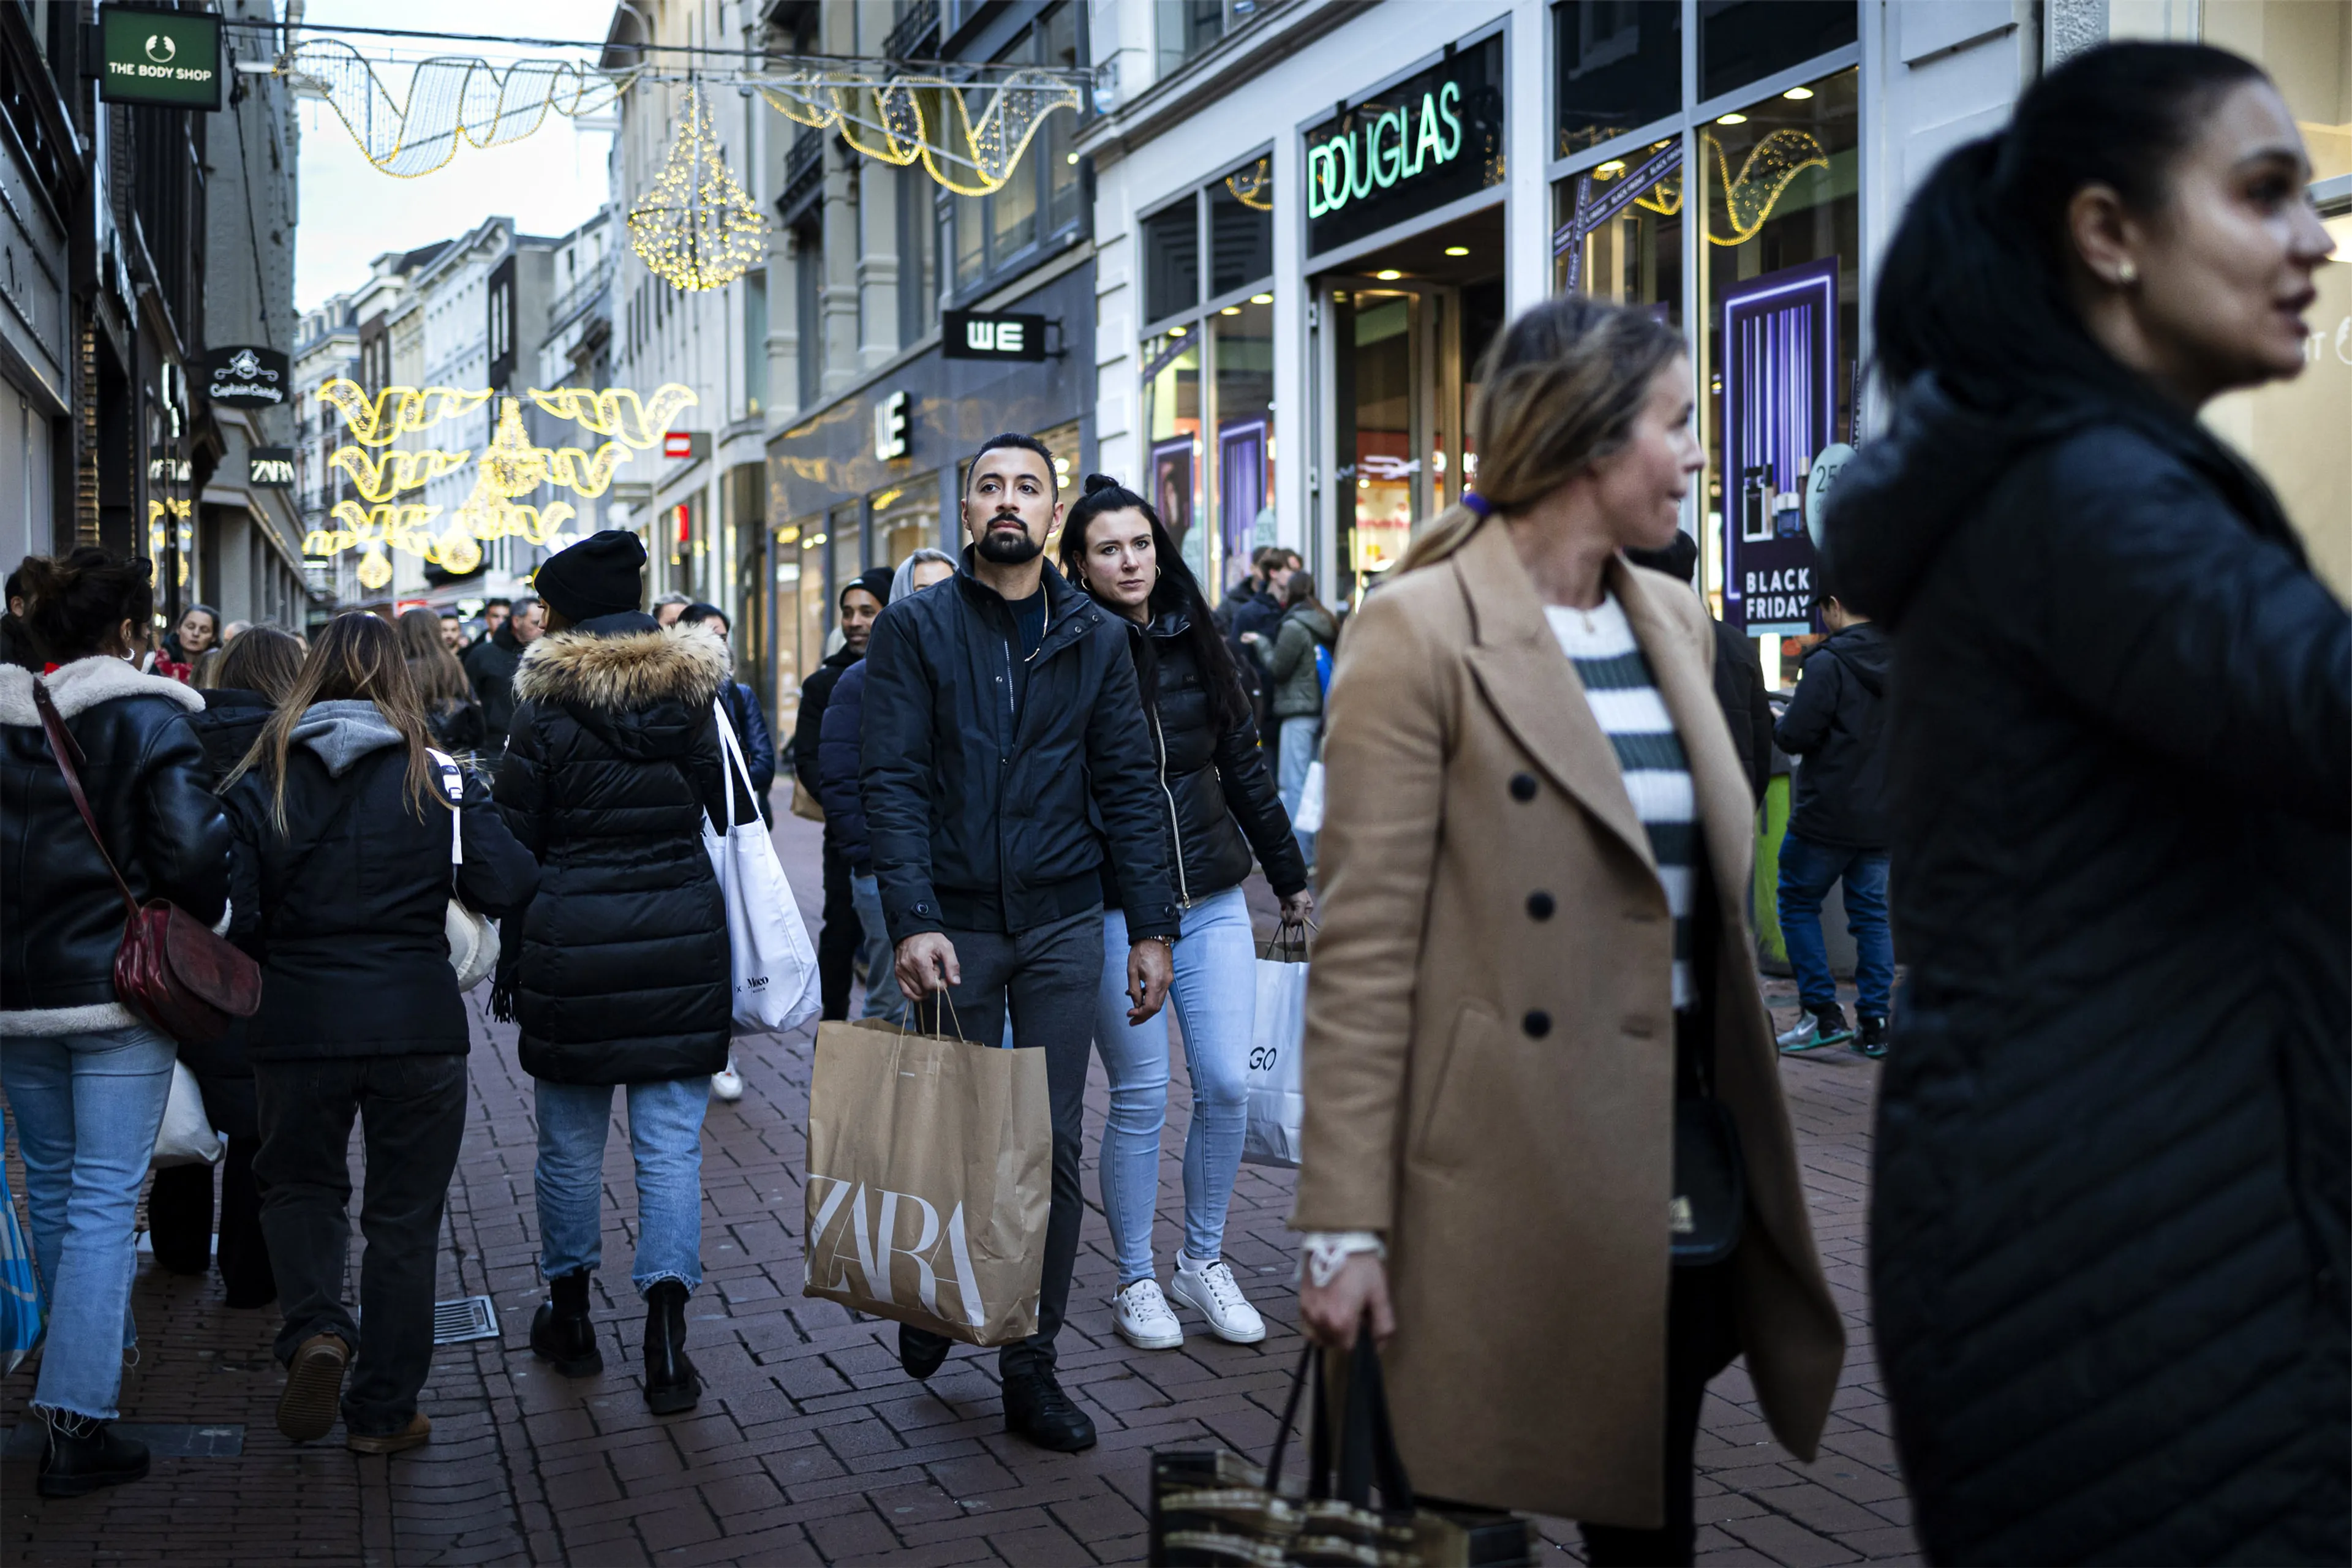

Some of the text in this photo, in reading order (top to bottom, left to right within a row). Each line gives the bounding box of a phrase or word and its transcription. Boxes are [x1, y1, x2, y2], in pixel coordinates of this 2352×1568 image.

[109, 62, 213, 81] THE BODY SHOP
[1308, 81, 1461, 219] DOUGLAS
[967, 321, 1024, 352] WE
[250, 383, 284, 403] Candy
[251, 460, 295, 483] ZARA
[1746, 567, 1810, 594] BLACK
[1746, 595, 1810, 620] FRIDAY
[747, 976, 769, 989] Moco
[804, 1172, 985, 1327] ZARA
